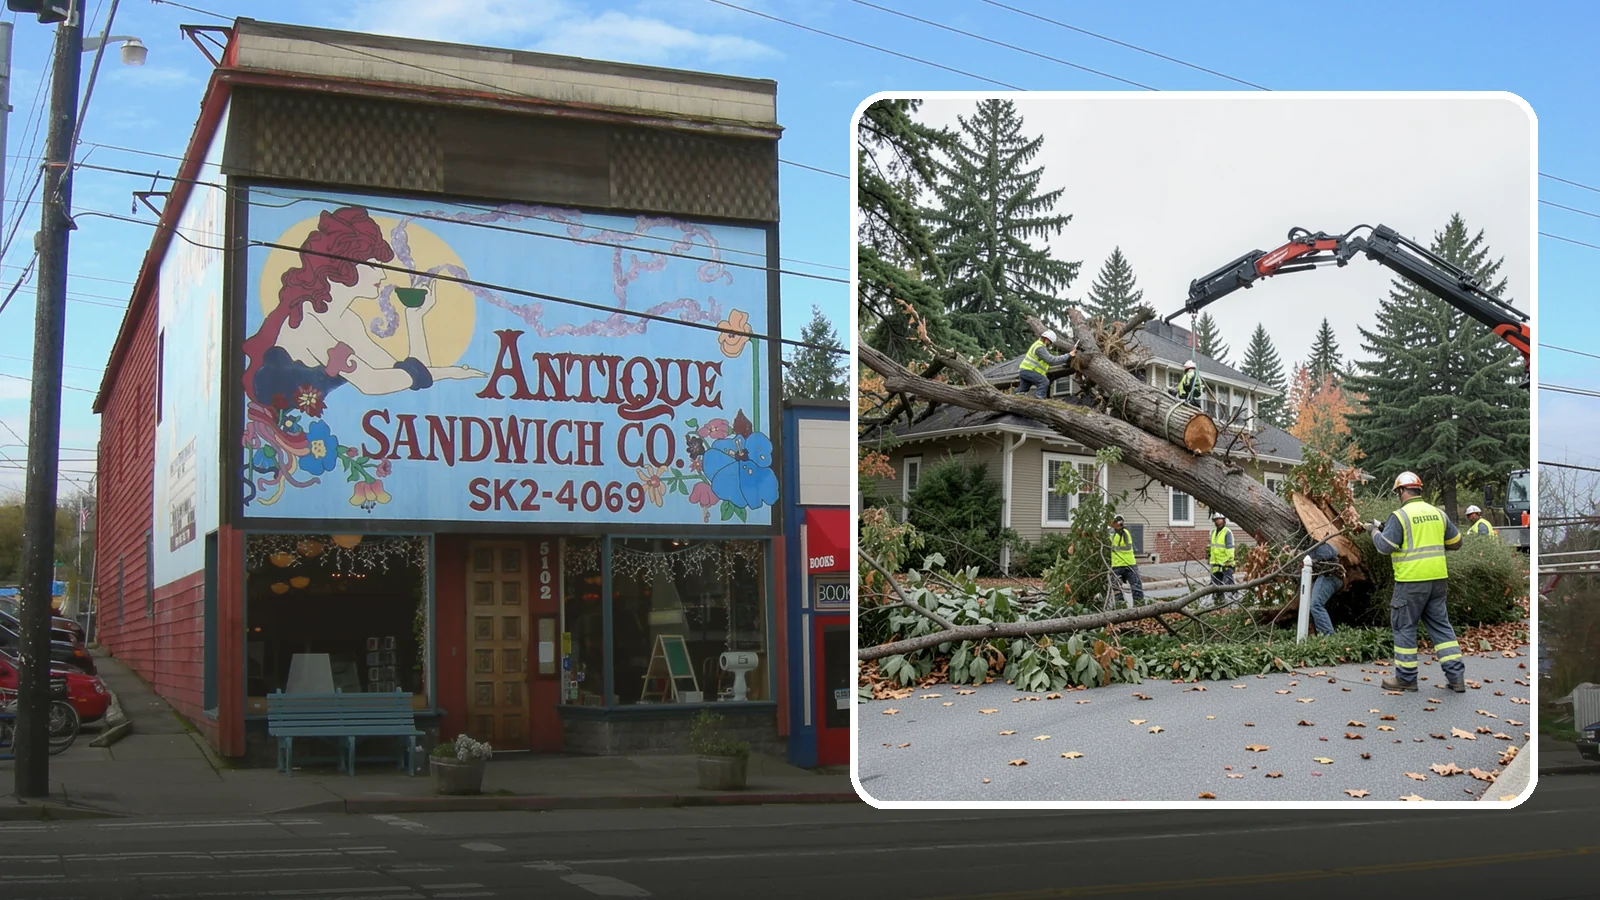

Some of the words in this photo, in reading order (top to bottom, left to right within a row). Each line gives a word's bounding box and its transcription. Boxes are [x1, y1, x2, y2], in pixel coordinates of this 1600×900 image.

[361, 408, 604, 467] SANDWICH
[617, 422, 685, 469] CO.
[469, 477, 646, 513] SK2-4069
[539, 542, 552, 600] 5102
[809, 555, 835, 569] BOOKS
